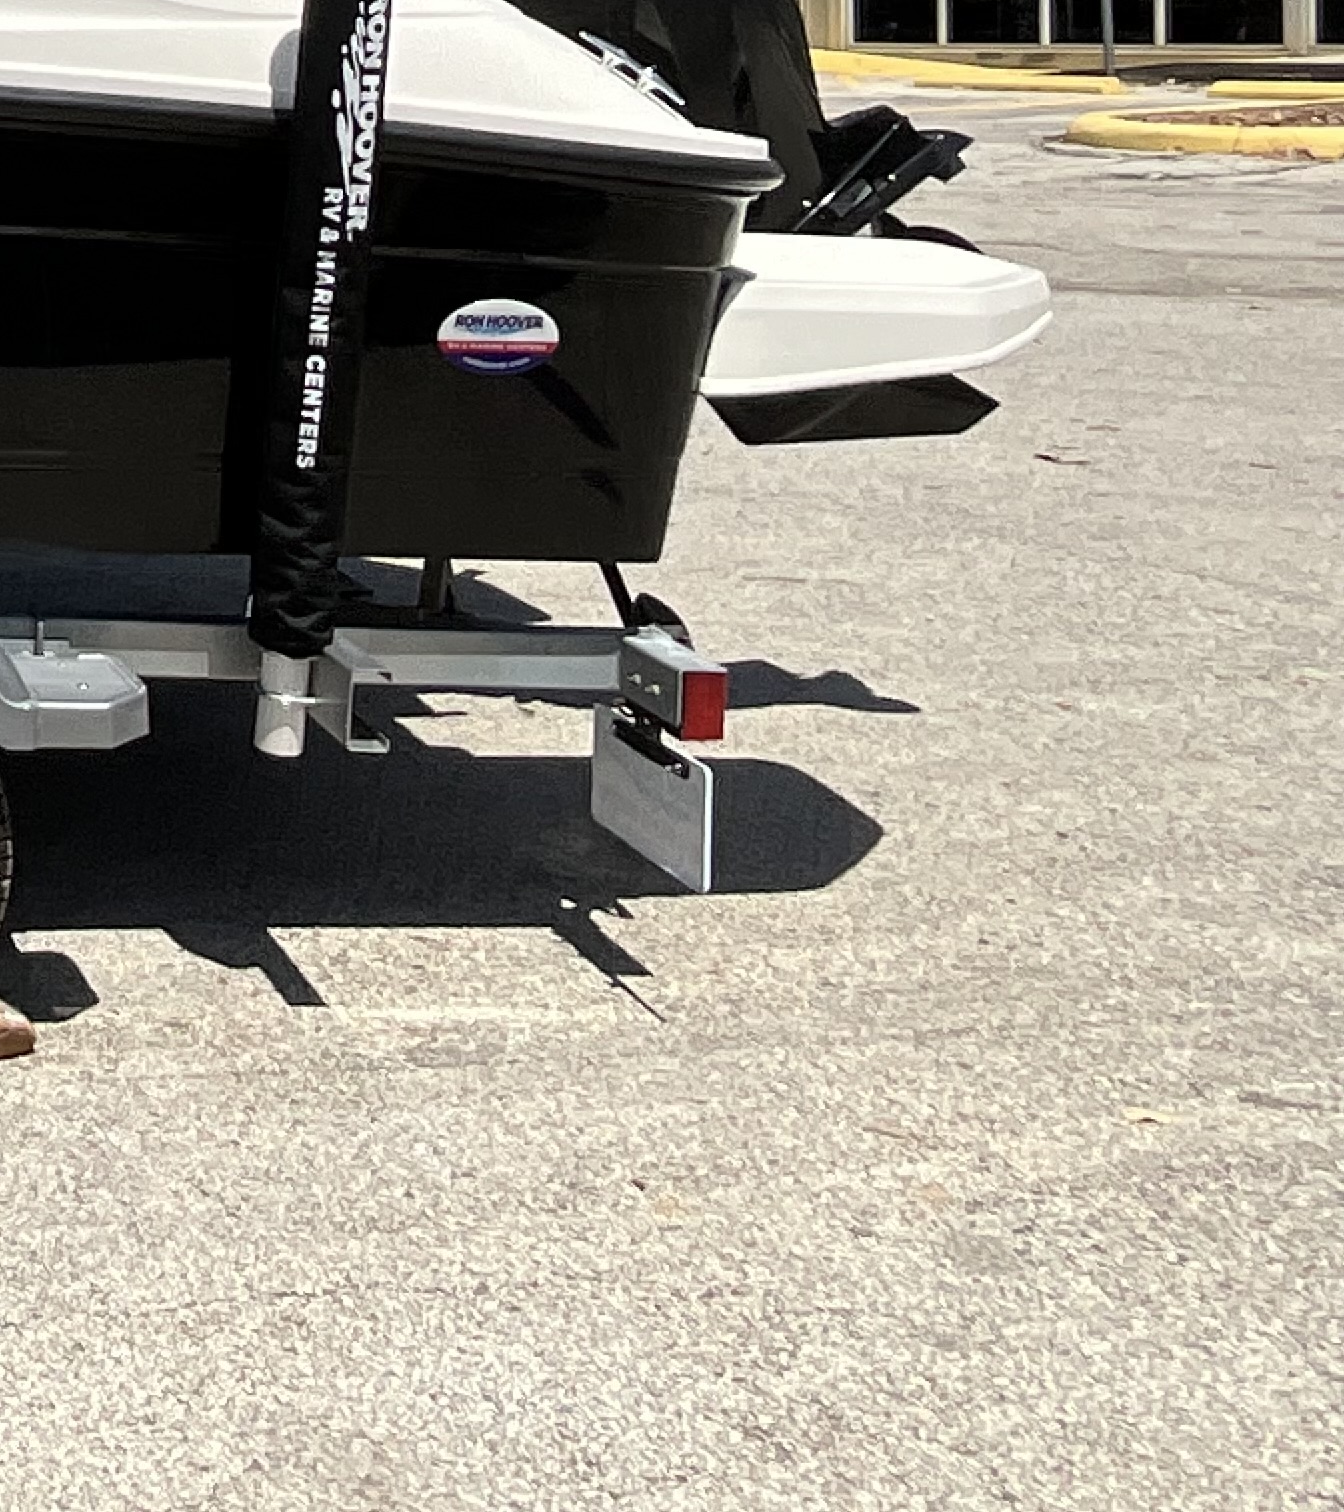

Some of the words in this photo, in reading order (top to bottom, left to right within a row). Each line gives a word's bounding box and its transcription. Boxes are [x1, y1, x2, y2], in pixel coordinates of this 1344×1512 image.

[346, 73, 381, 231] HOOVER
[319, 226, 340, 244] &
[322, 187, 344, 223] RV
[308, 251, 337, 347] MARINE
[296, 355, 326, 469] CENTERS
